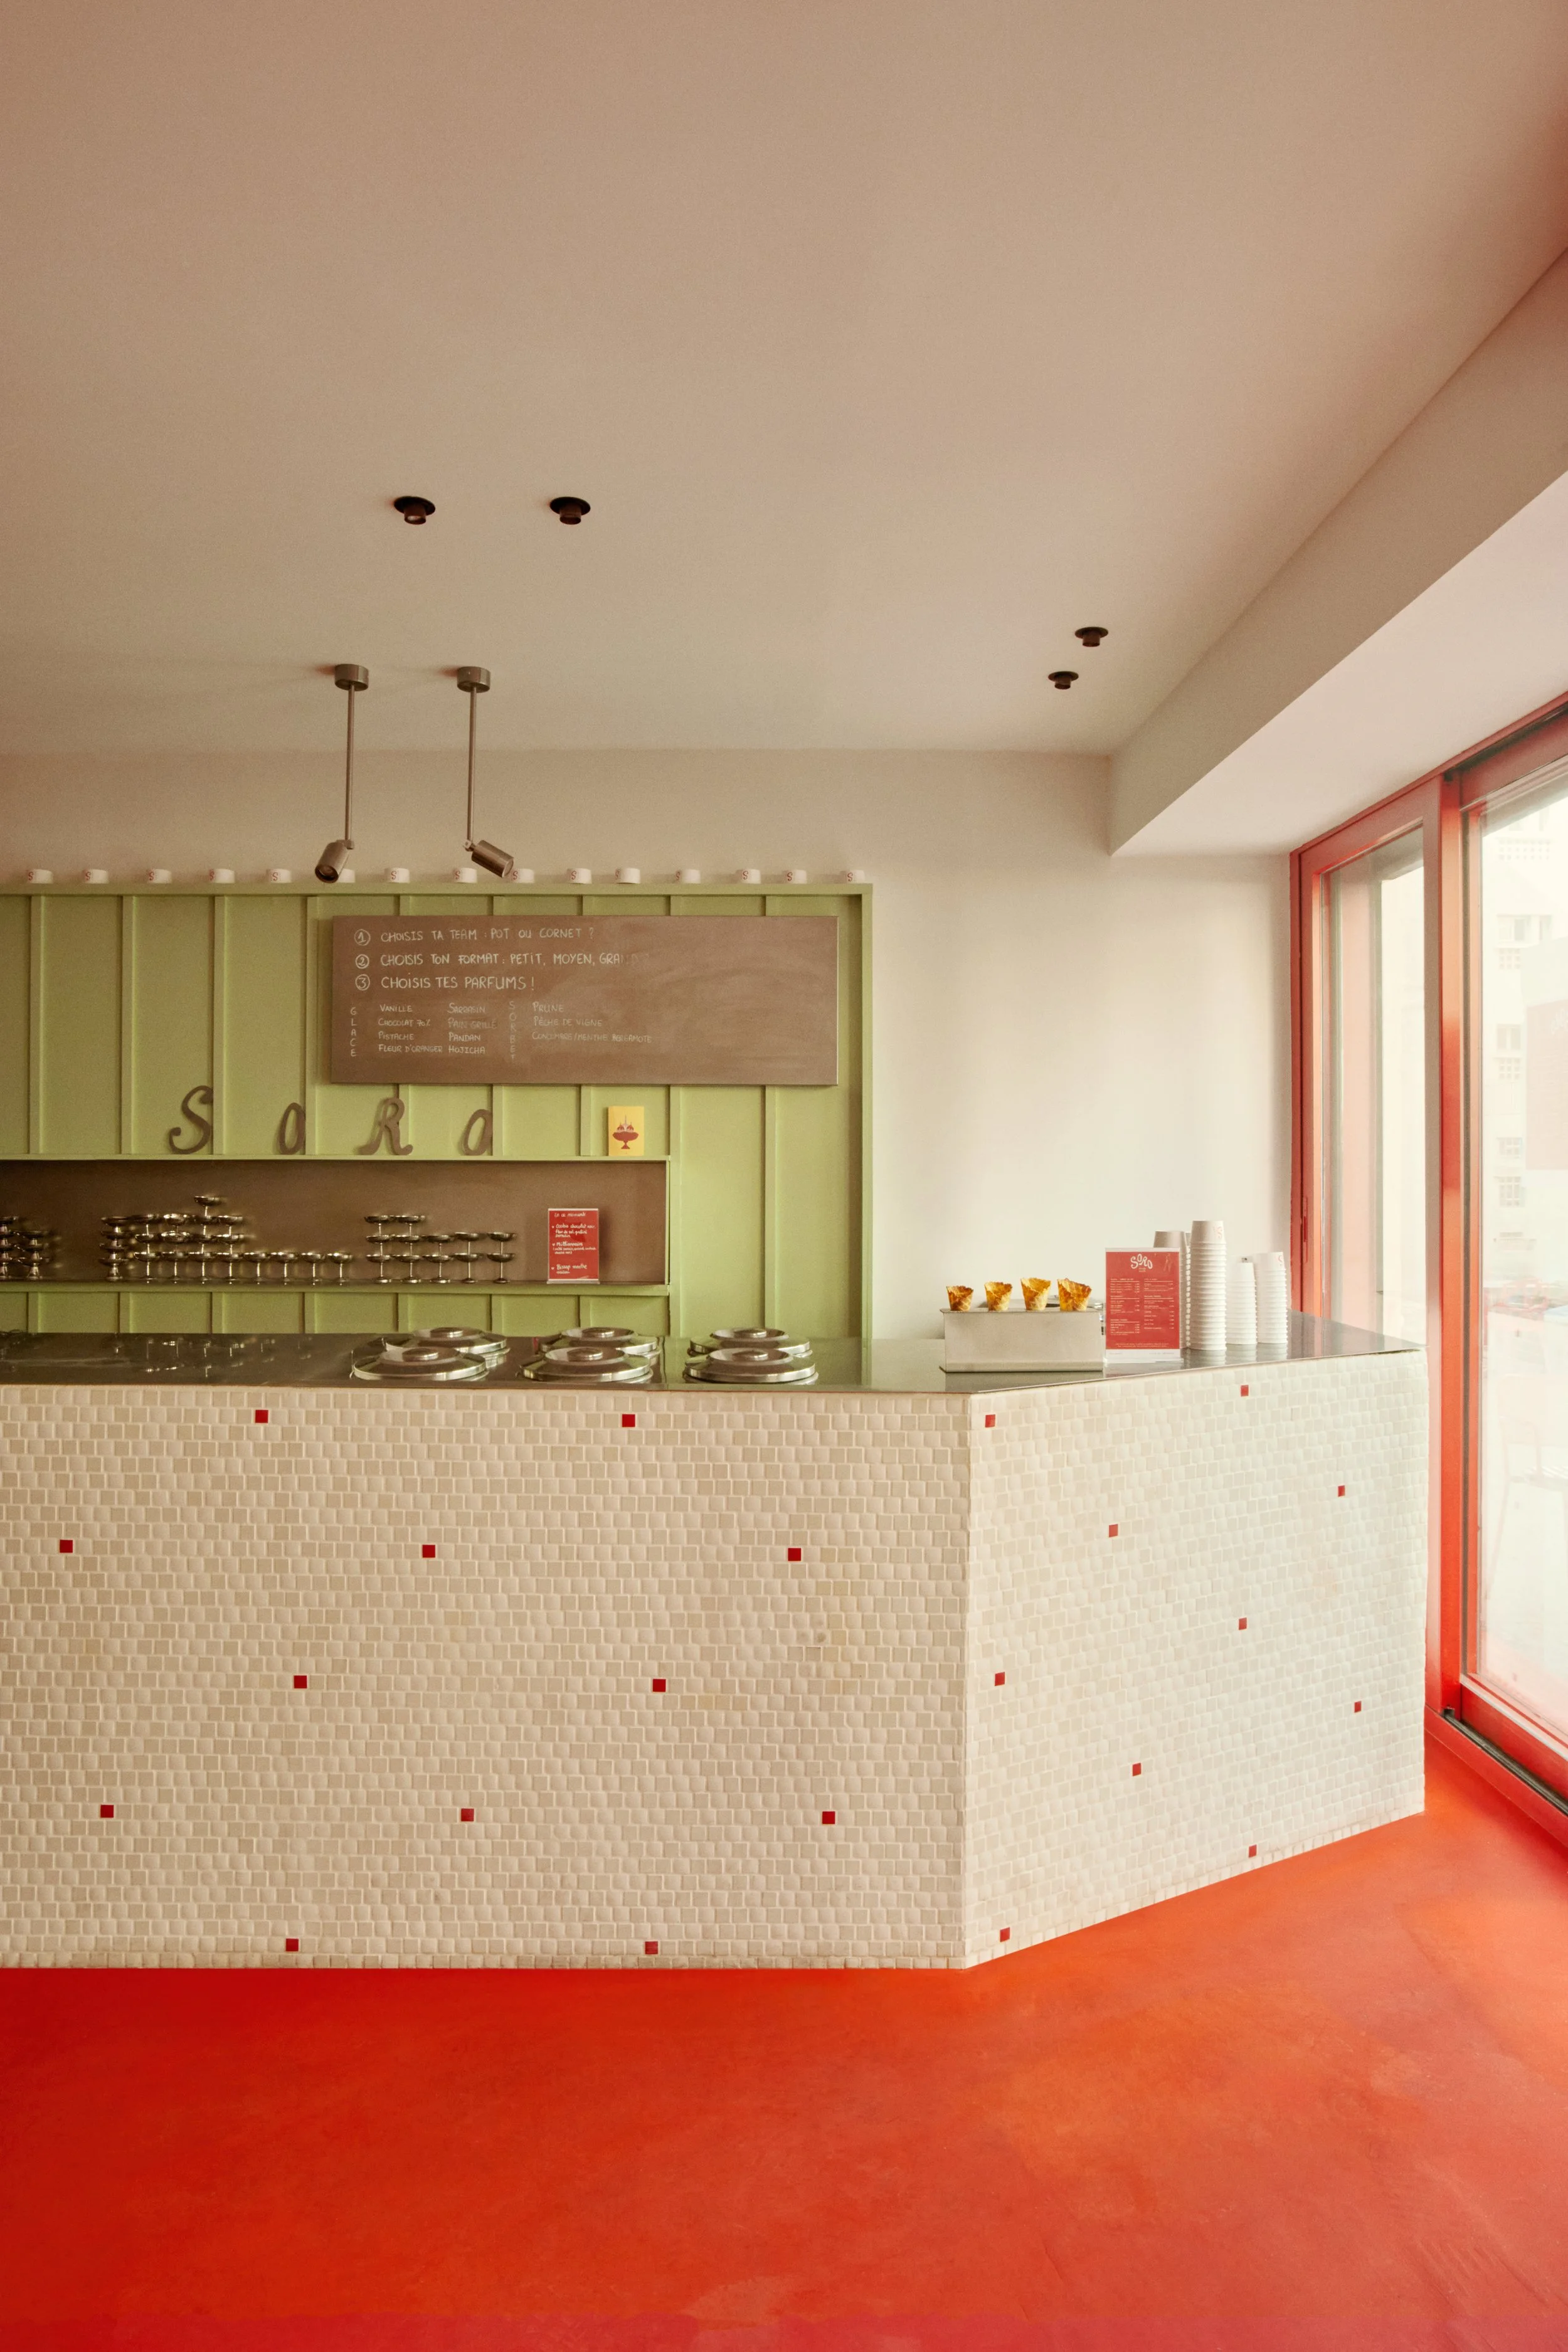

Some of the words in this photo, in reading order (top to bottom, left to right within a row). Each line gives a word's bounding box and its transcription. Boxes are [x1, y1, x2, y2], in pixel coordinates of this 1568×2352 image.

[381, 931, 423, 942] CHOISIS
[431, 930, 444, 941] TA
[449, 929, 477, 940] TEAM
[490, 928, 509, 940] POT
[518, 929, 532, 939] OU
[539, 928, 582, 939] CORNET
[380, 954, 424, 966] CHOISIS
[430, 953, 450, 965] TON
[381, 973, 431, 989] CHOISIS
[435, 977, 458, 988] TES
